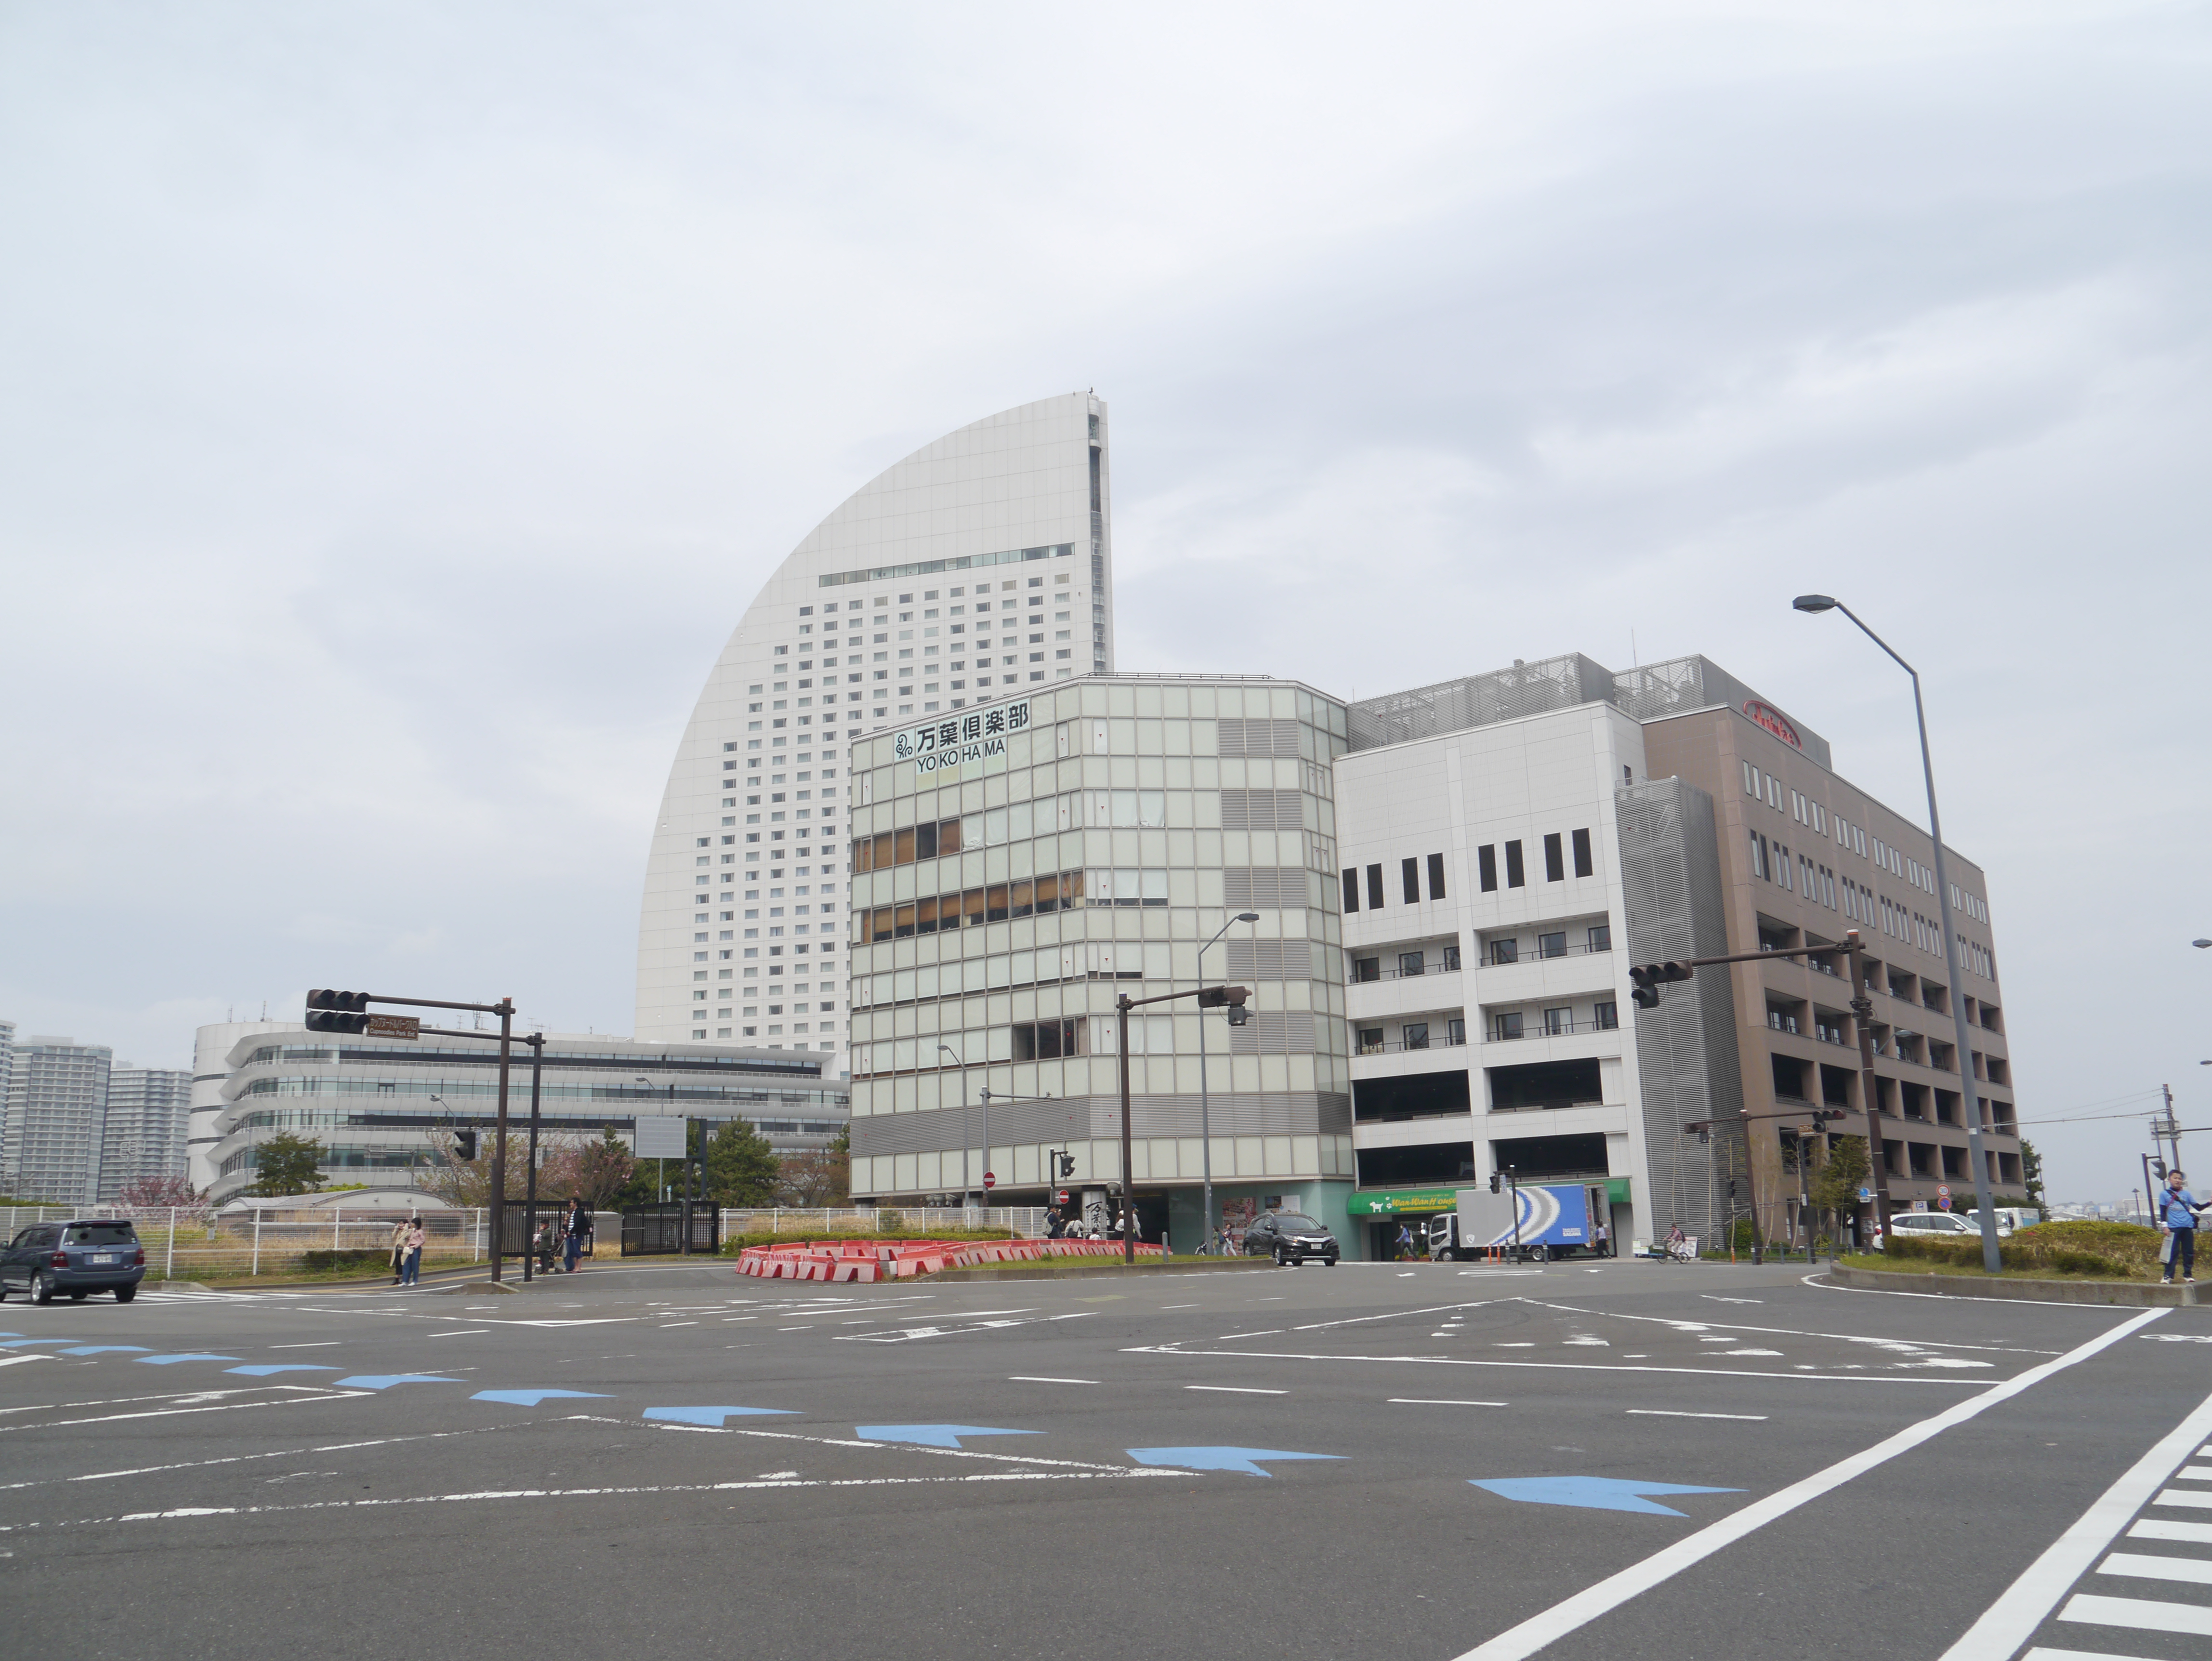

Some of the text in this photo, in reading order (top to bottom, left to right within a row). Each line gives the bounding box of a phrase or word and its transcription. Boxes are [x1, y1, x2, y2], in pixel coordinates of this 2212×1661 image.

[917, 703, 1028, 753] 万葉倶楽部
